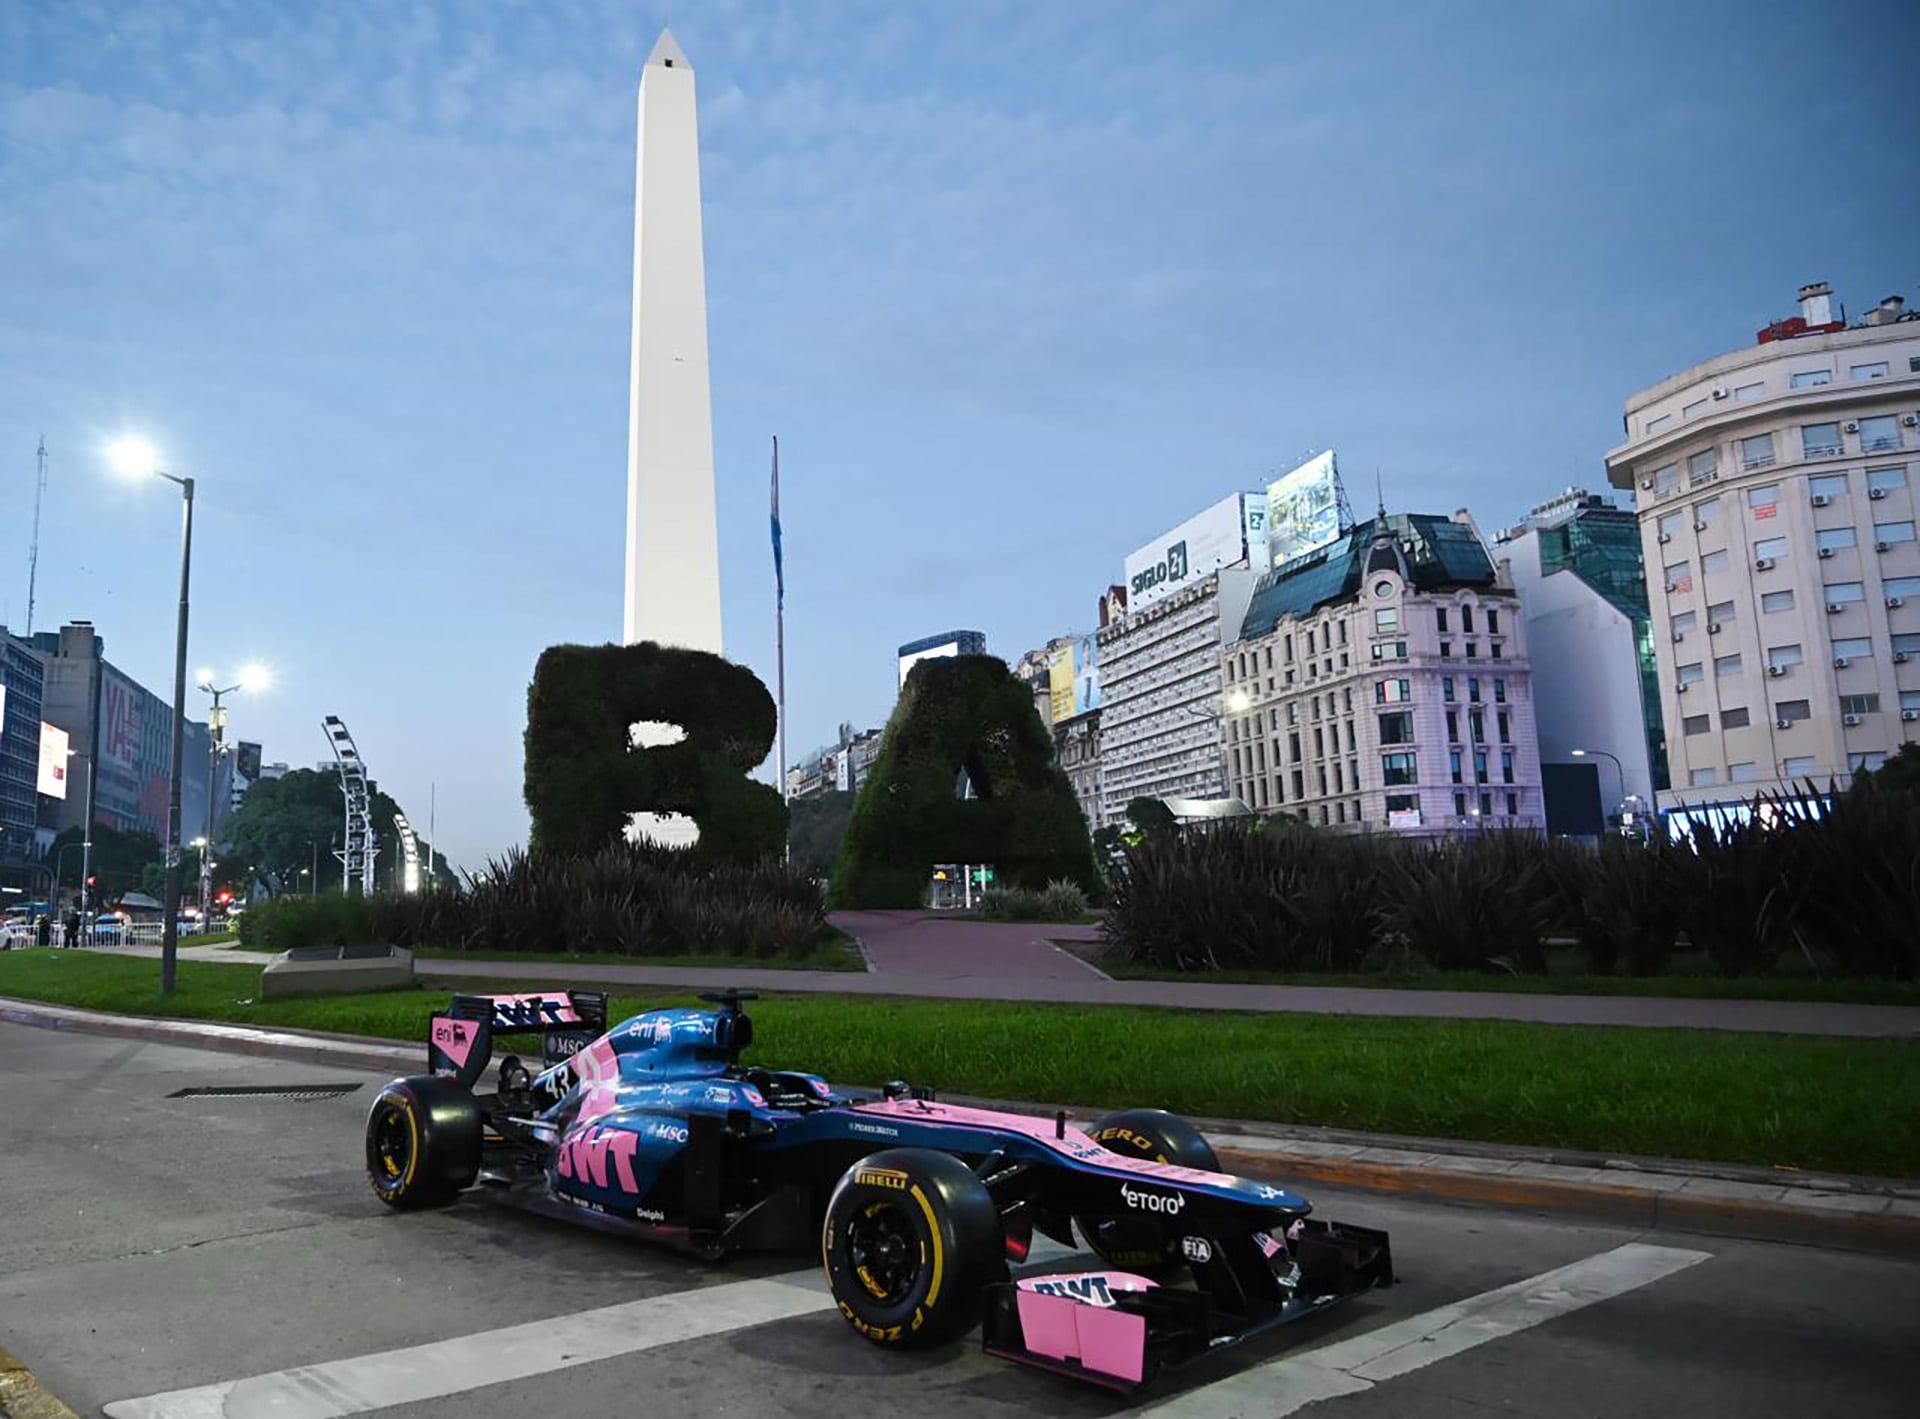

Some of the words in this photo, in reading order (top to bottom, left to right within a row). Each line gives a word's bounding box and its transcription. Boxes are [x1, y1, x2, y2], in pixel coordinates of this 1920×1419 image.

[1131, 561, 1168, 596] SIGLO
[436, 1024, 452, 1042] eni
[628, 1019, 656, 1039] eni
[545, 1066, 571, 1100] 43
[656, 1124, 689, 1143] MSC
[1184, 1238, 1209, 1258] FIA
